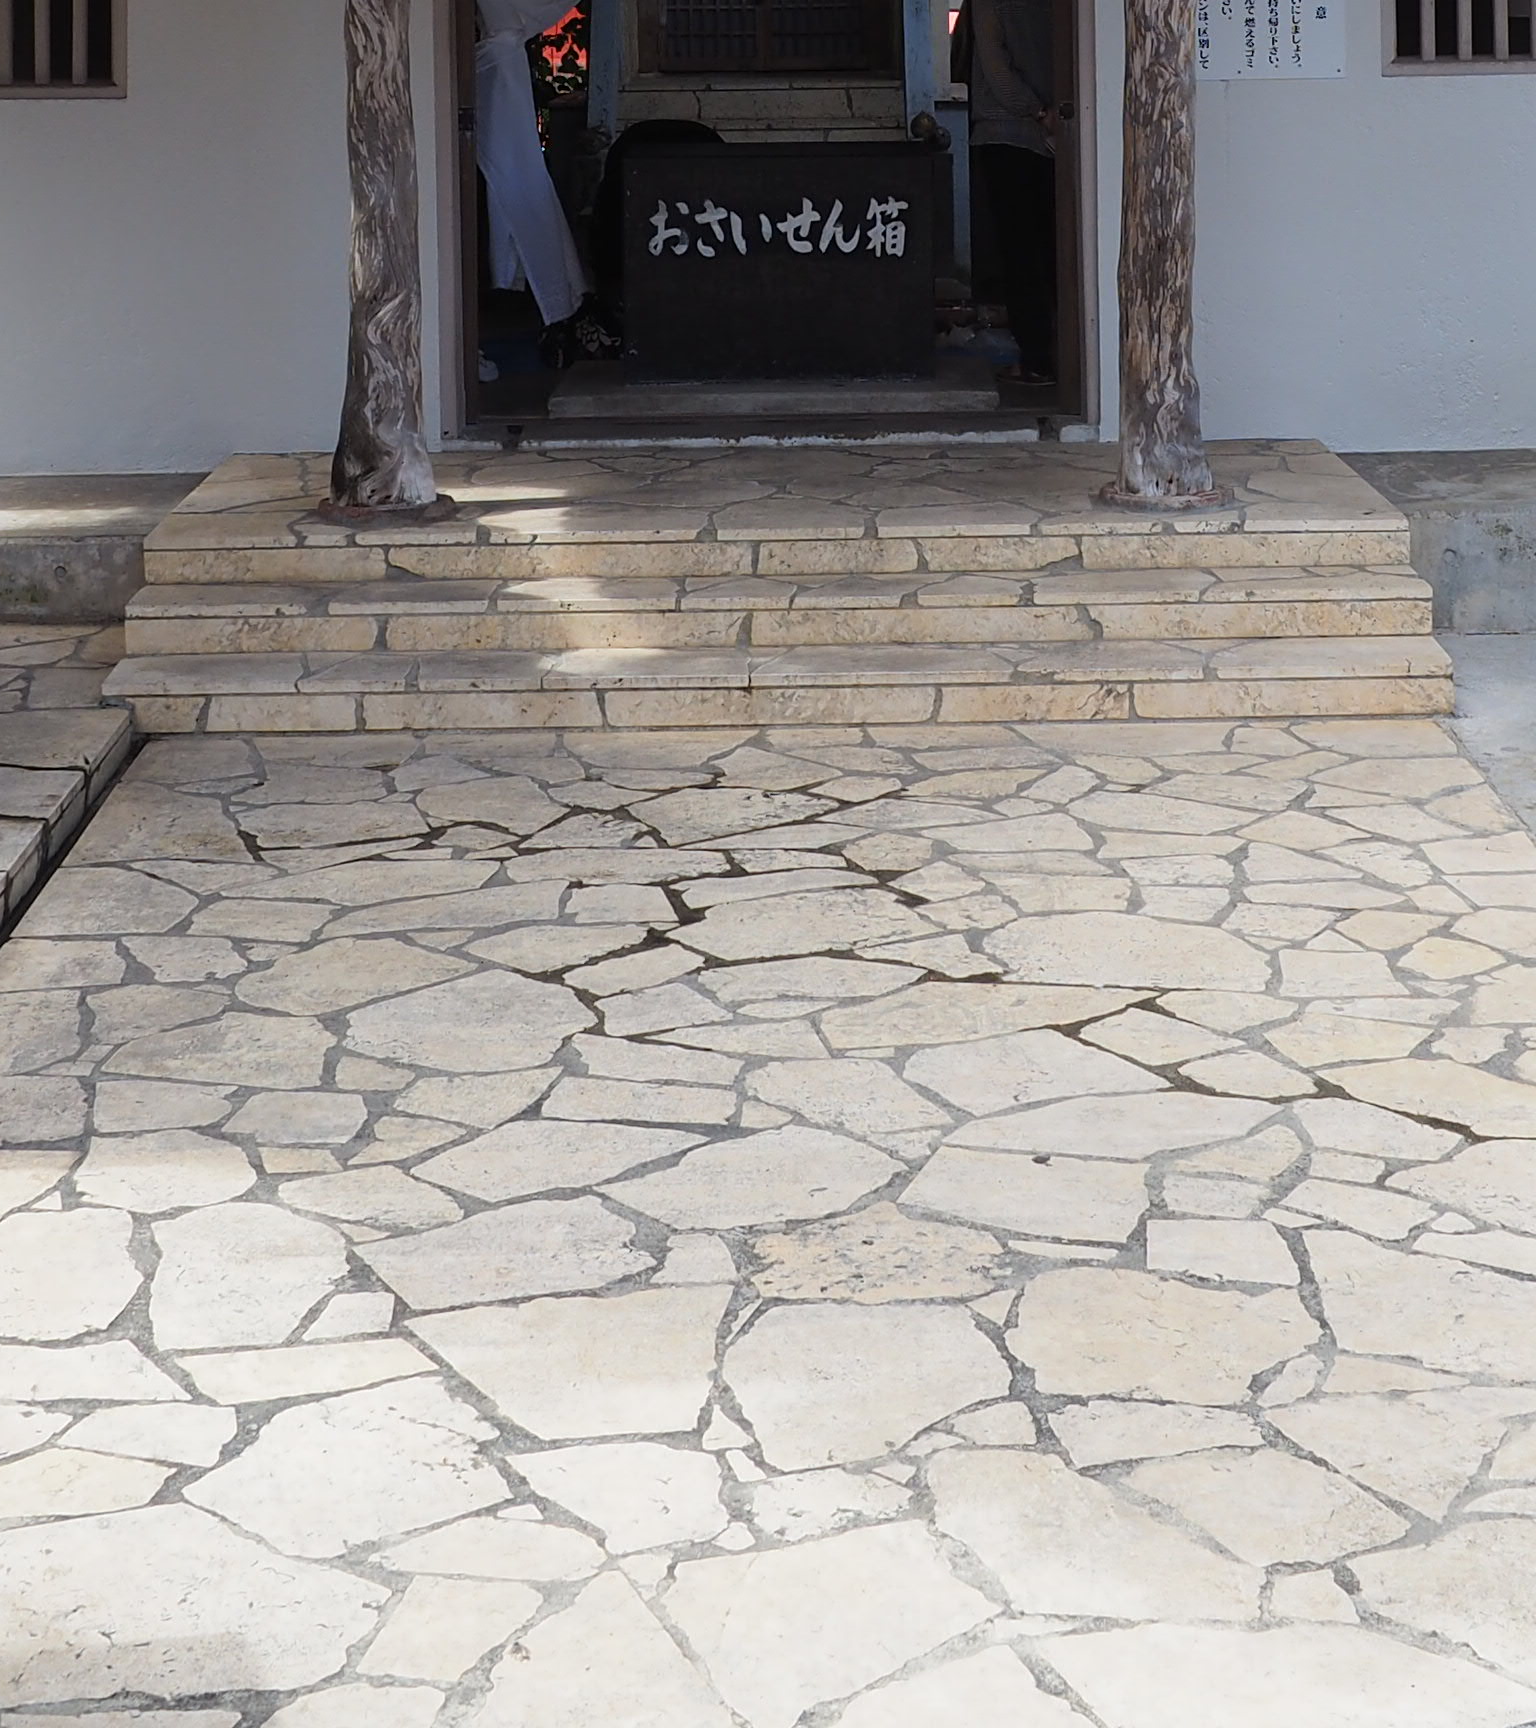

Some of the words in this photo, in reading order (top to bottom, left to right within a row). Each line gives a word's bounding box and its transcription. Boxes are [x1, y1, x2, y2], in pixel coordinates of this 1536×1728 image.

[647, 195, 910, 258] おさいせん箱
